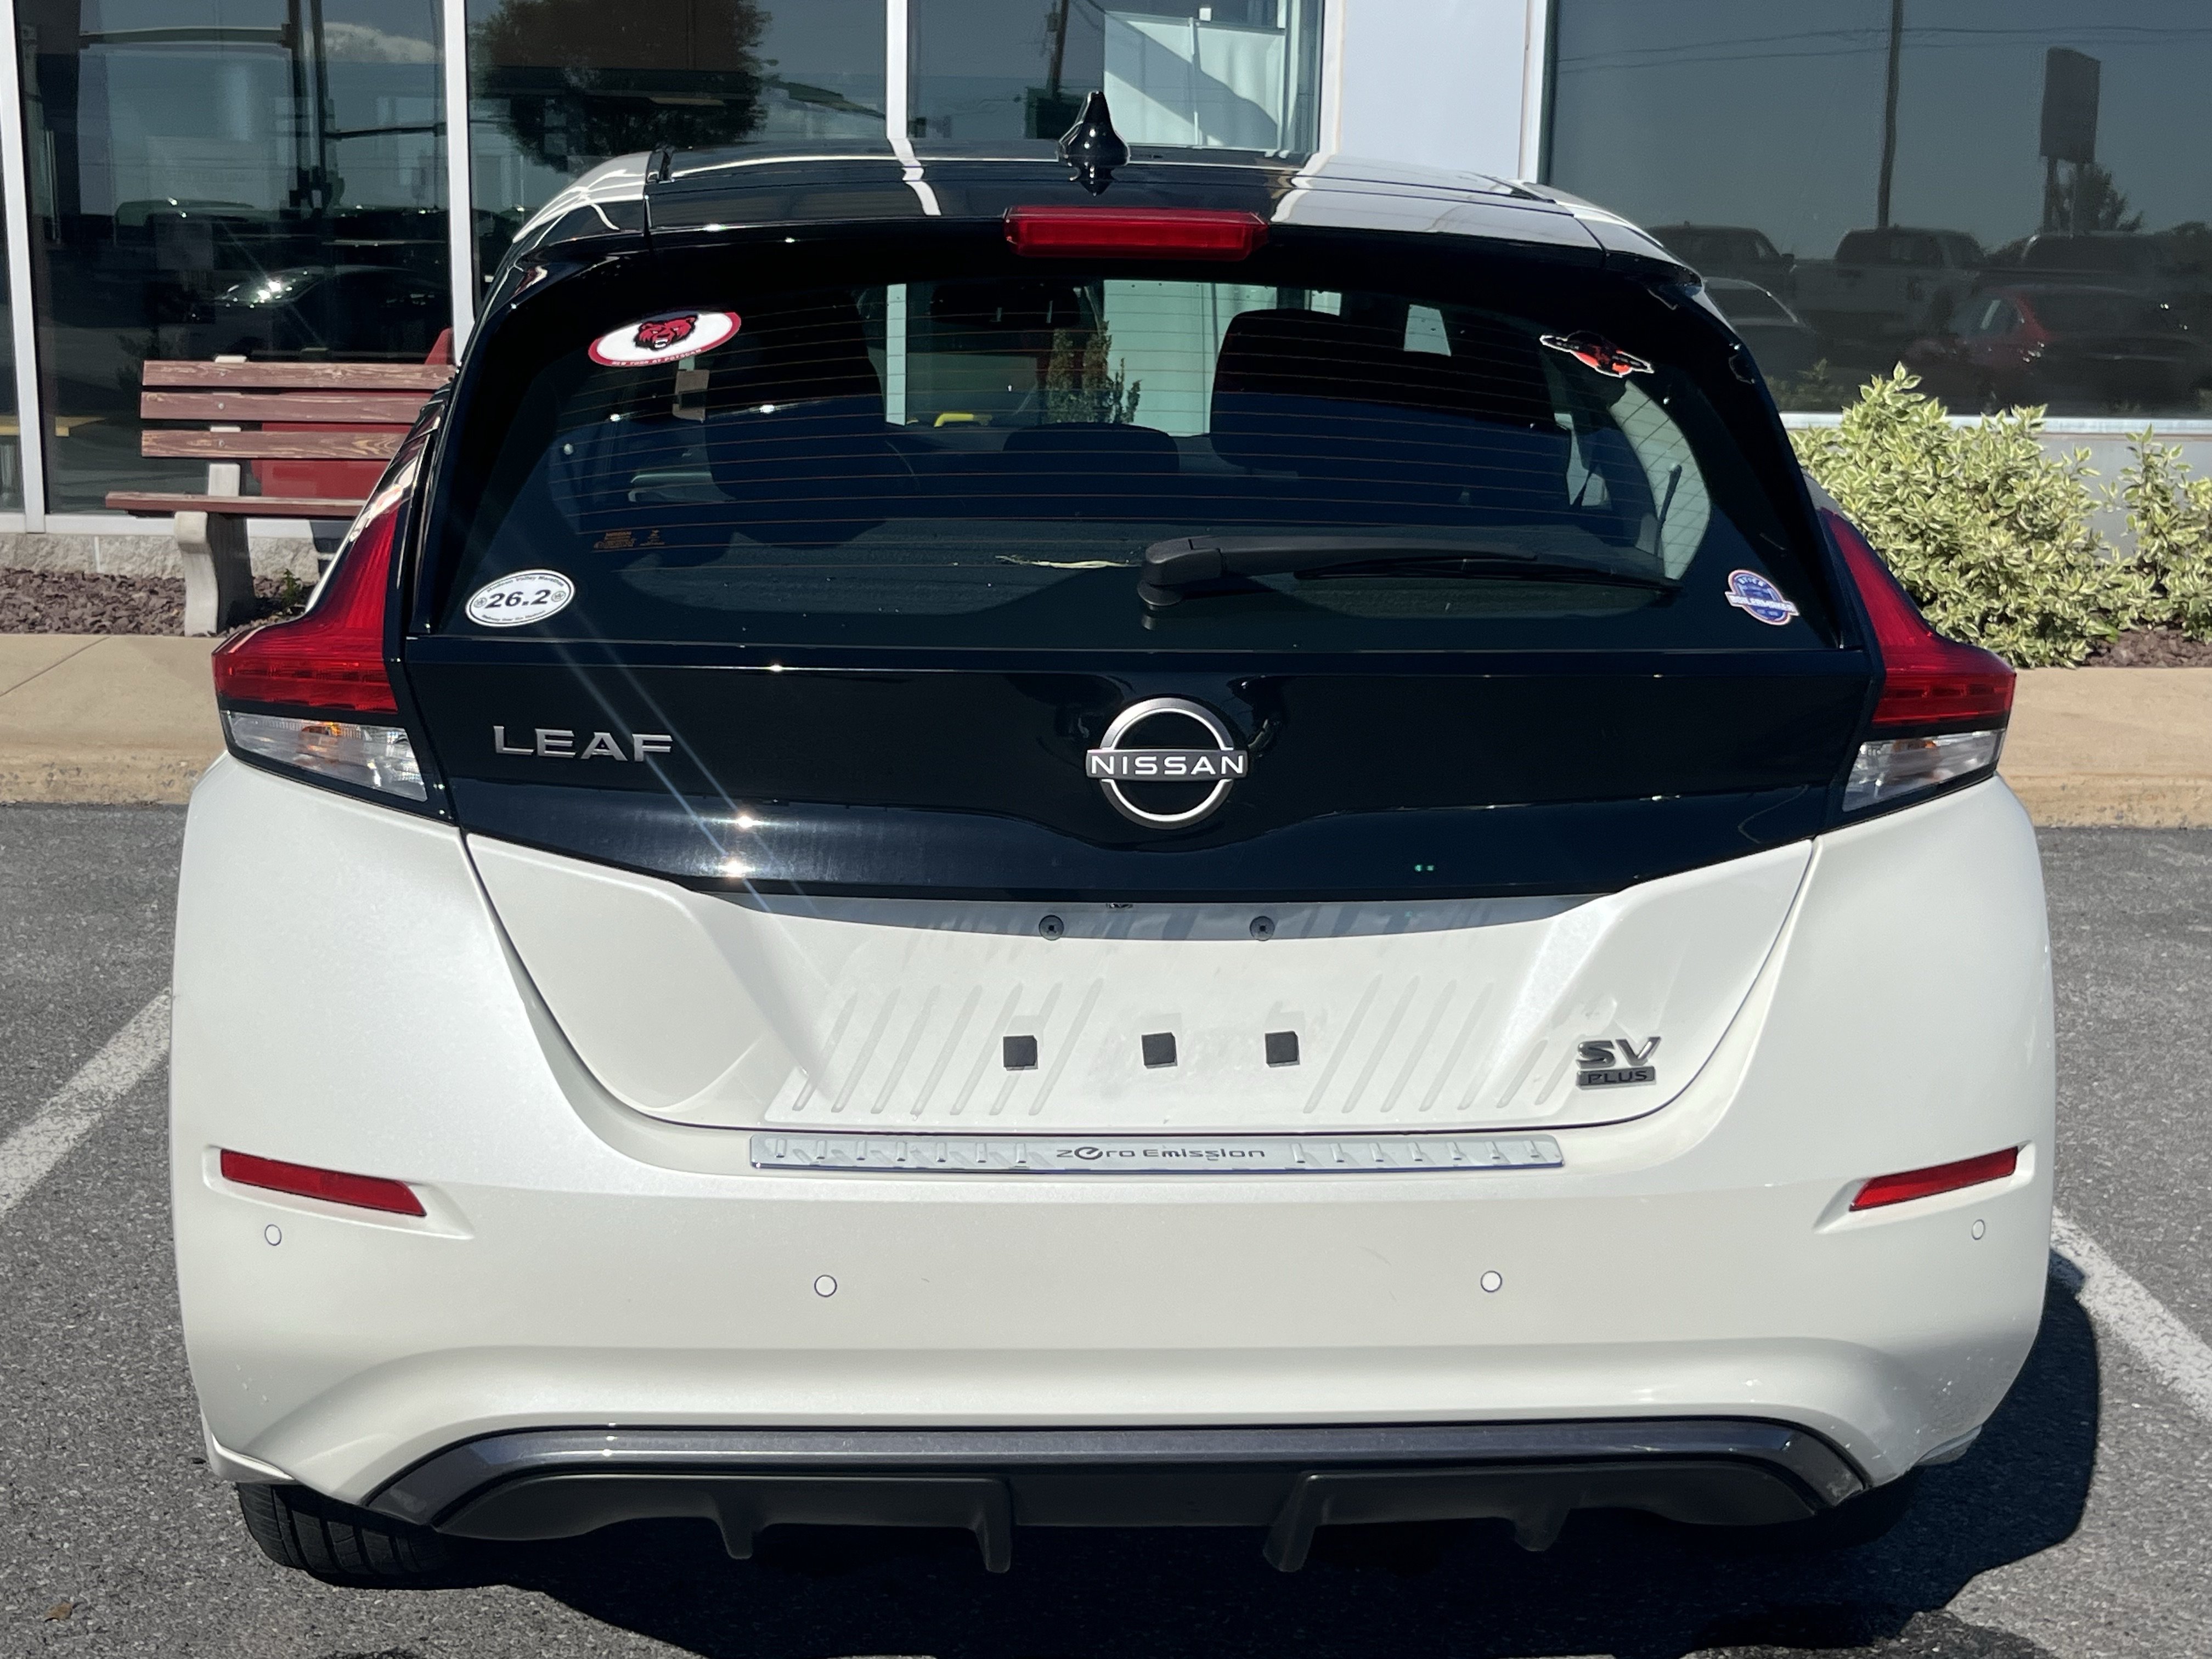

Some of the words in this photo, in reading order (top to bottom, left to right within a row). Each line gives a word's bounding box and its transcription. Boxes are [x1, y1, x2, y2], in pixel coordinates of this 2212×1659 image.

[485, 589, 551, 609] 26.2
[493, 725, 673, 761] LEAF
[1091, 755, 1244, 775] NISSAN
[1576, 1036, 1661, 1070] SV
[1588, 1070, 1647, 1084] PLUS
[1143, 1148, 1266, 1161] Emission
